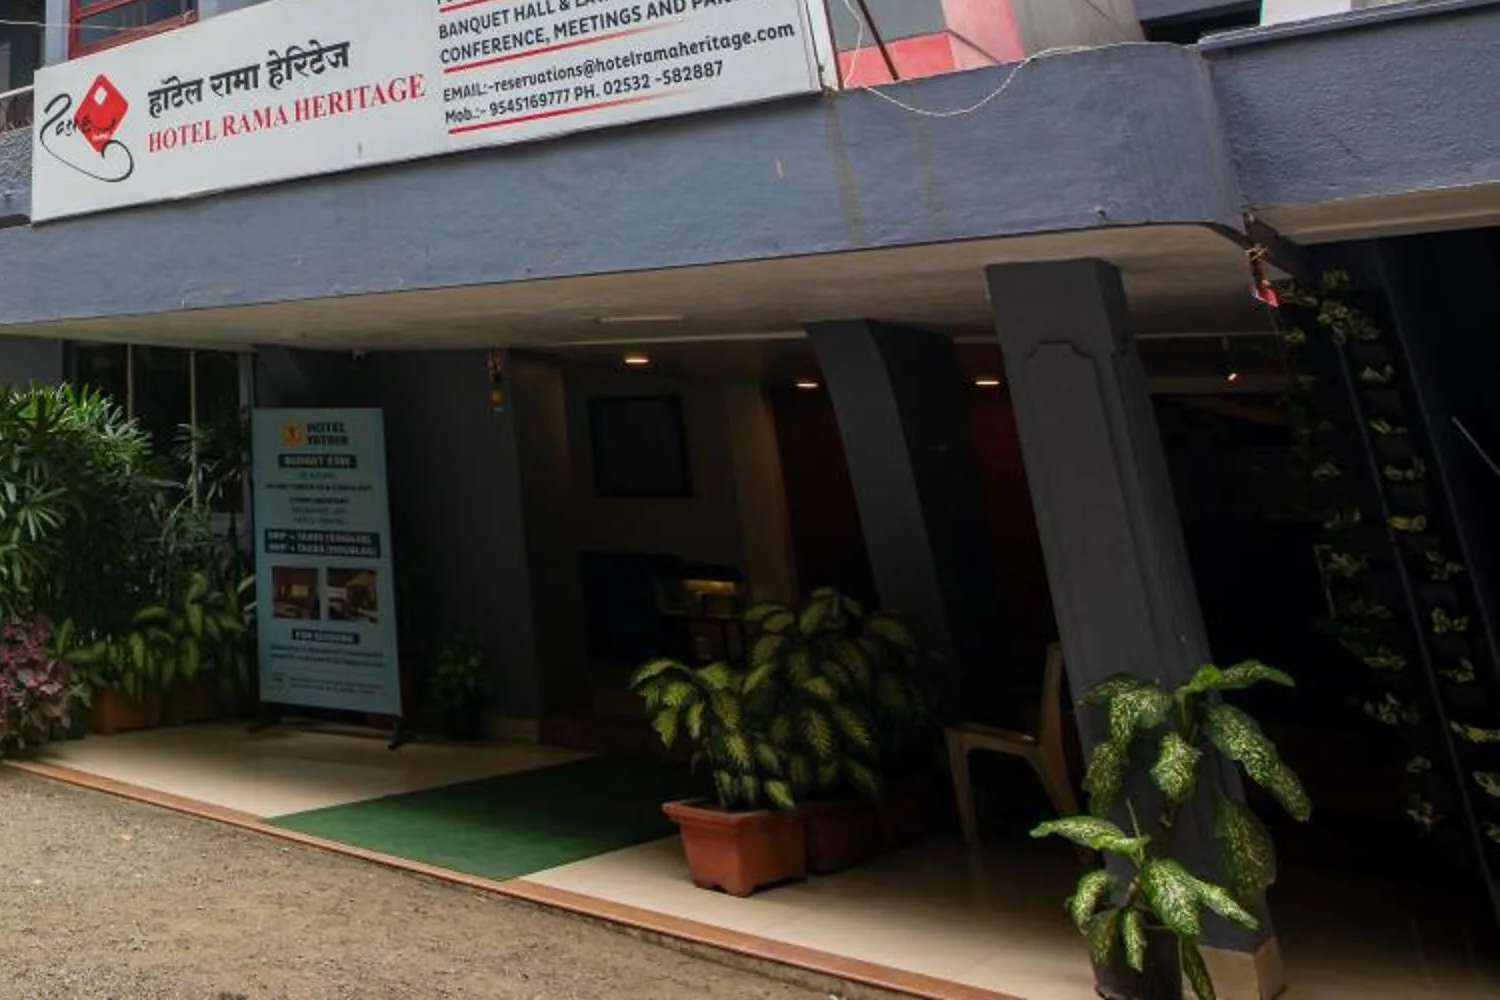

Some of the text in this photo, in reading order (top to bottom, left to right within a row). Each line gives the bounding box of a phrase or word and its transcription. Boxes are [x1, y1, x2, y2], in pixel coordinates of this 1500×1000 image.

[439, 9, 511, 40] BANQUET
[513, 0, 556, 22] HALL
[440, 26, 551, 65] CONFERENCE,
[553, 5, 642, 40] MEETINGS
[147, 75, 204, 119] हॉटेल
[209, 63, 261, 98] रामा
[265, 39, 351, 91] हेरिटेज
[488, 88, 571, 117] 9545169777
[573, 83, 600, 102] PH.
[603, 73, 652, 96] 02532
[148, 73, 426, 153] HOTEL RAMA HERITAGE
